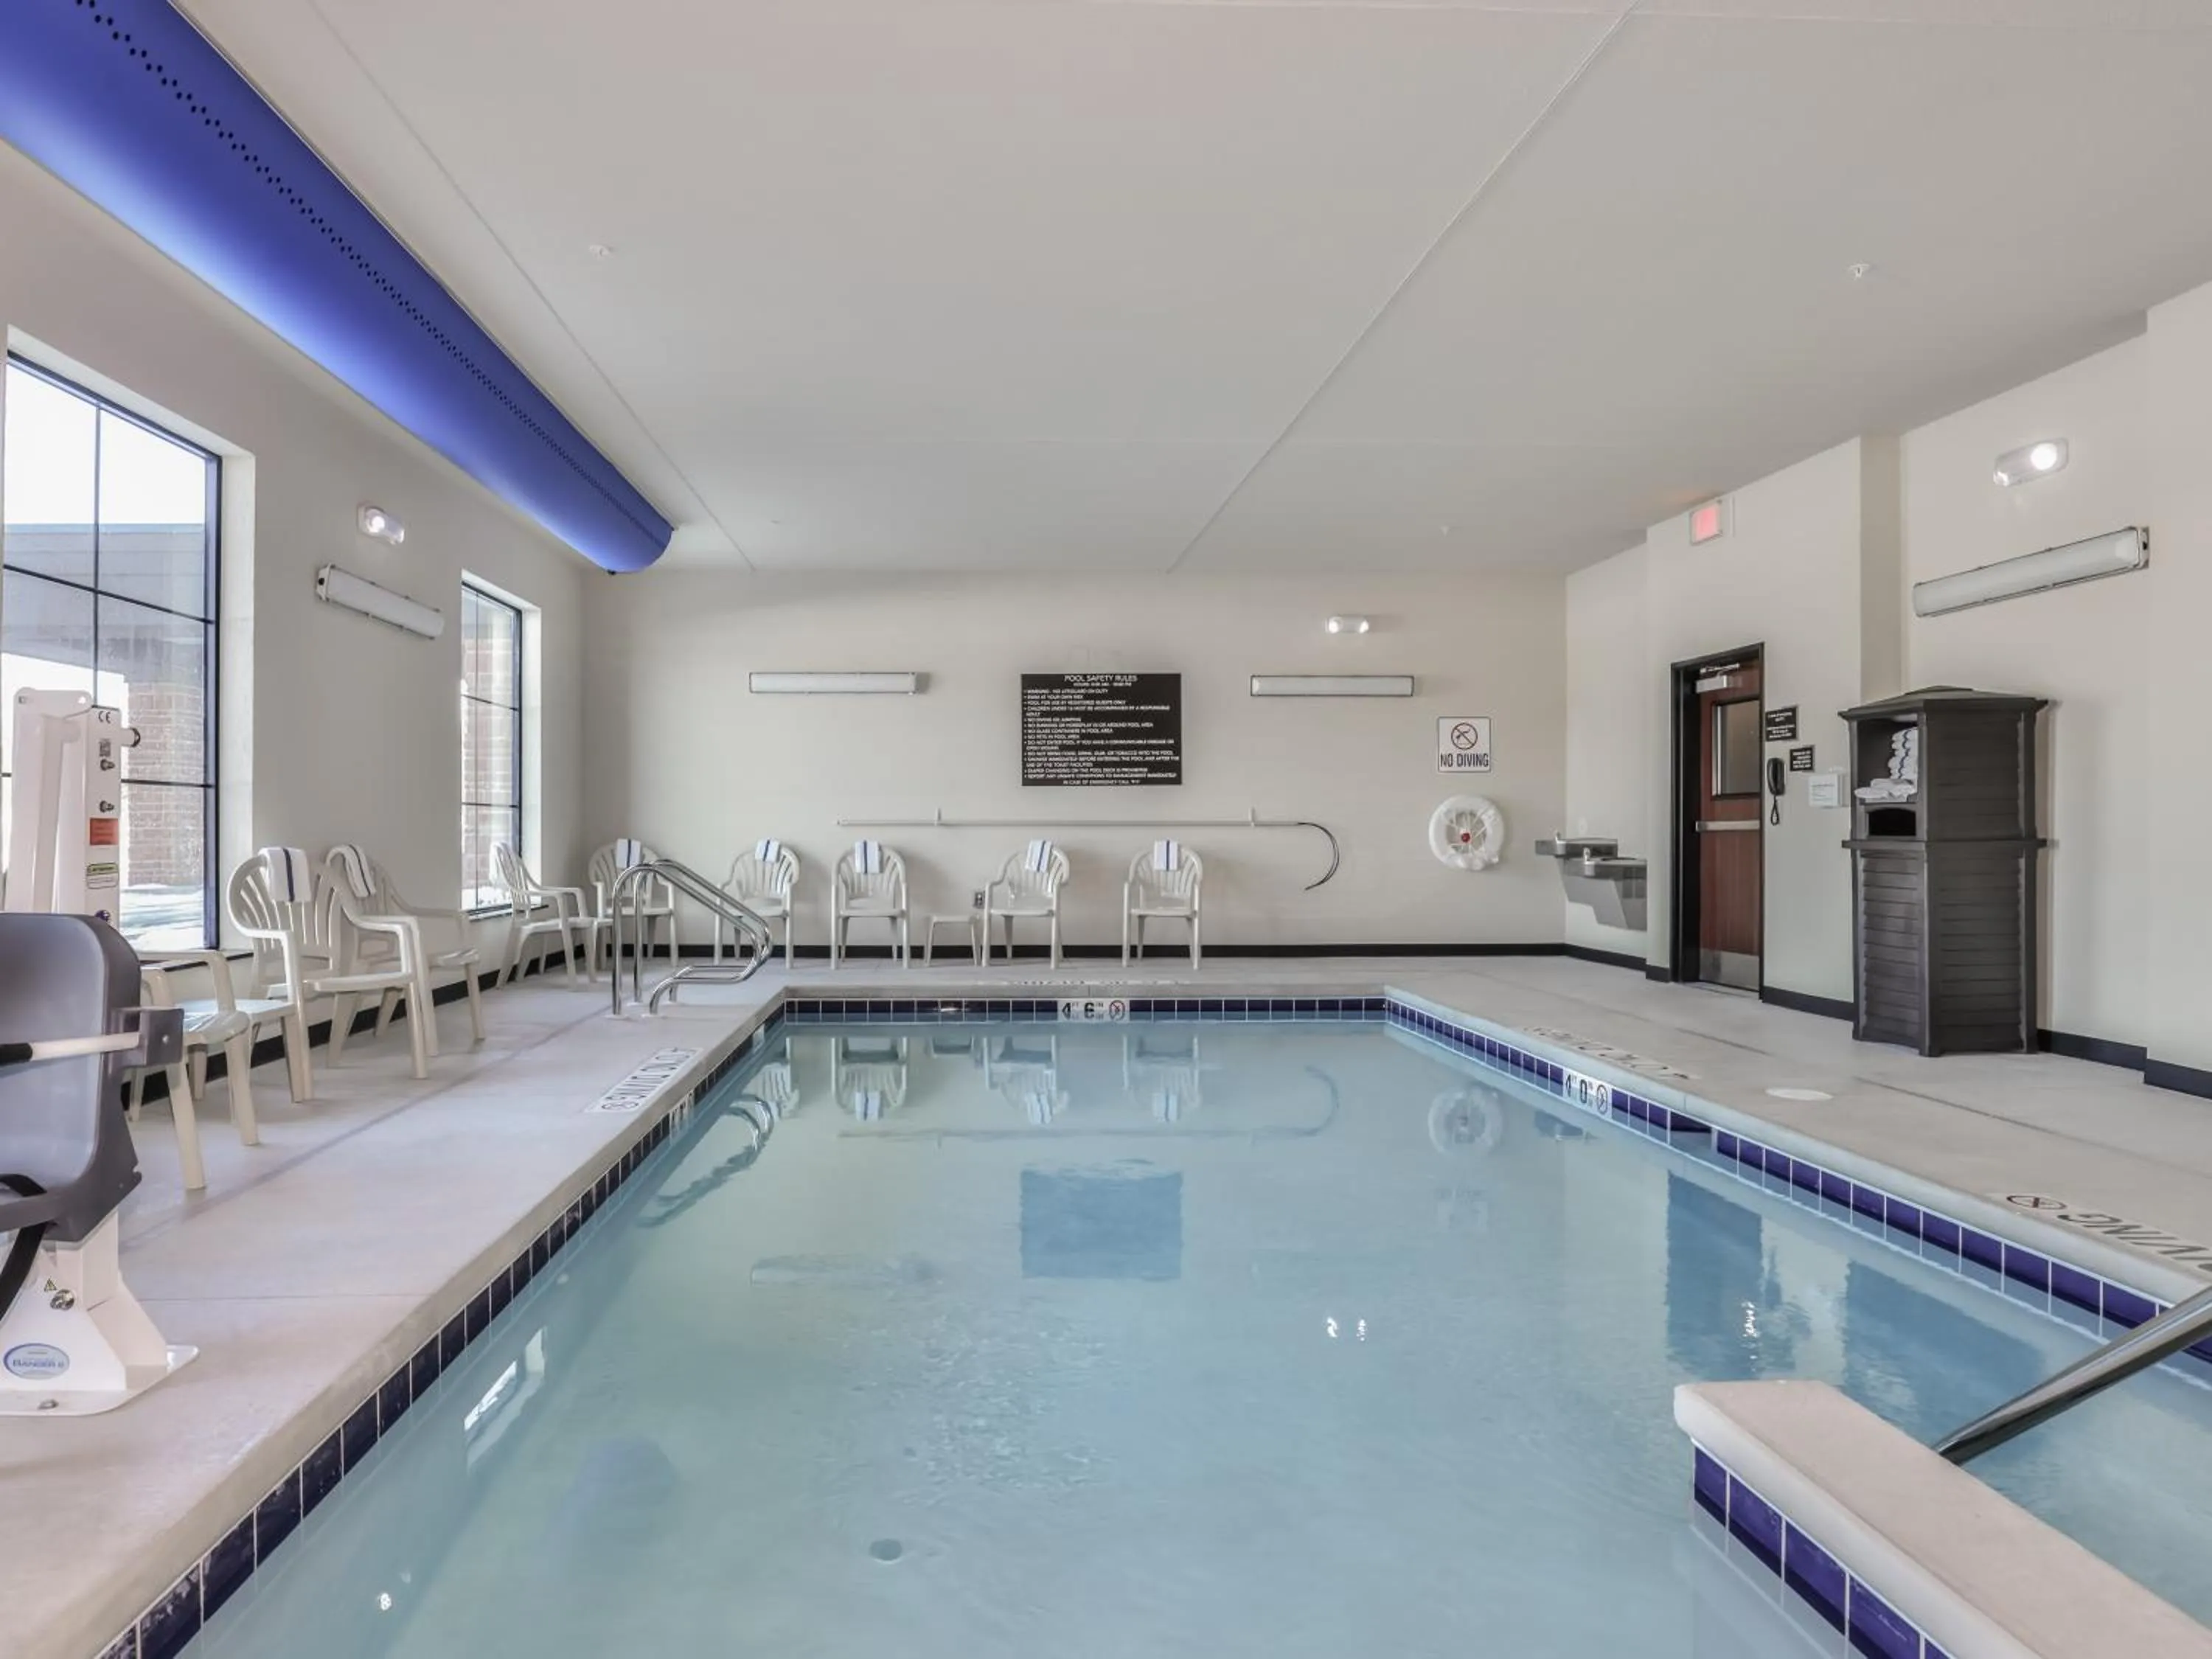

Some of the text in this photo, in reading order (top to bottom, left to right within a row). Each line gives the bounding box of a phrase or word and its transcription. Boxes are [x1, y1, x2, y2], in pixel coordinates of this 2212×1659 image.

[1440, 753, 1489, 767] NO DIVING
[2056, 1214, 2212, 1272] IVING
